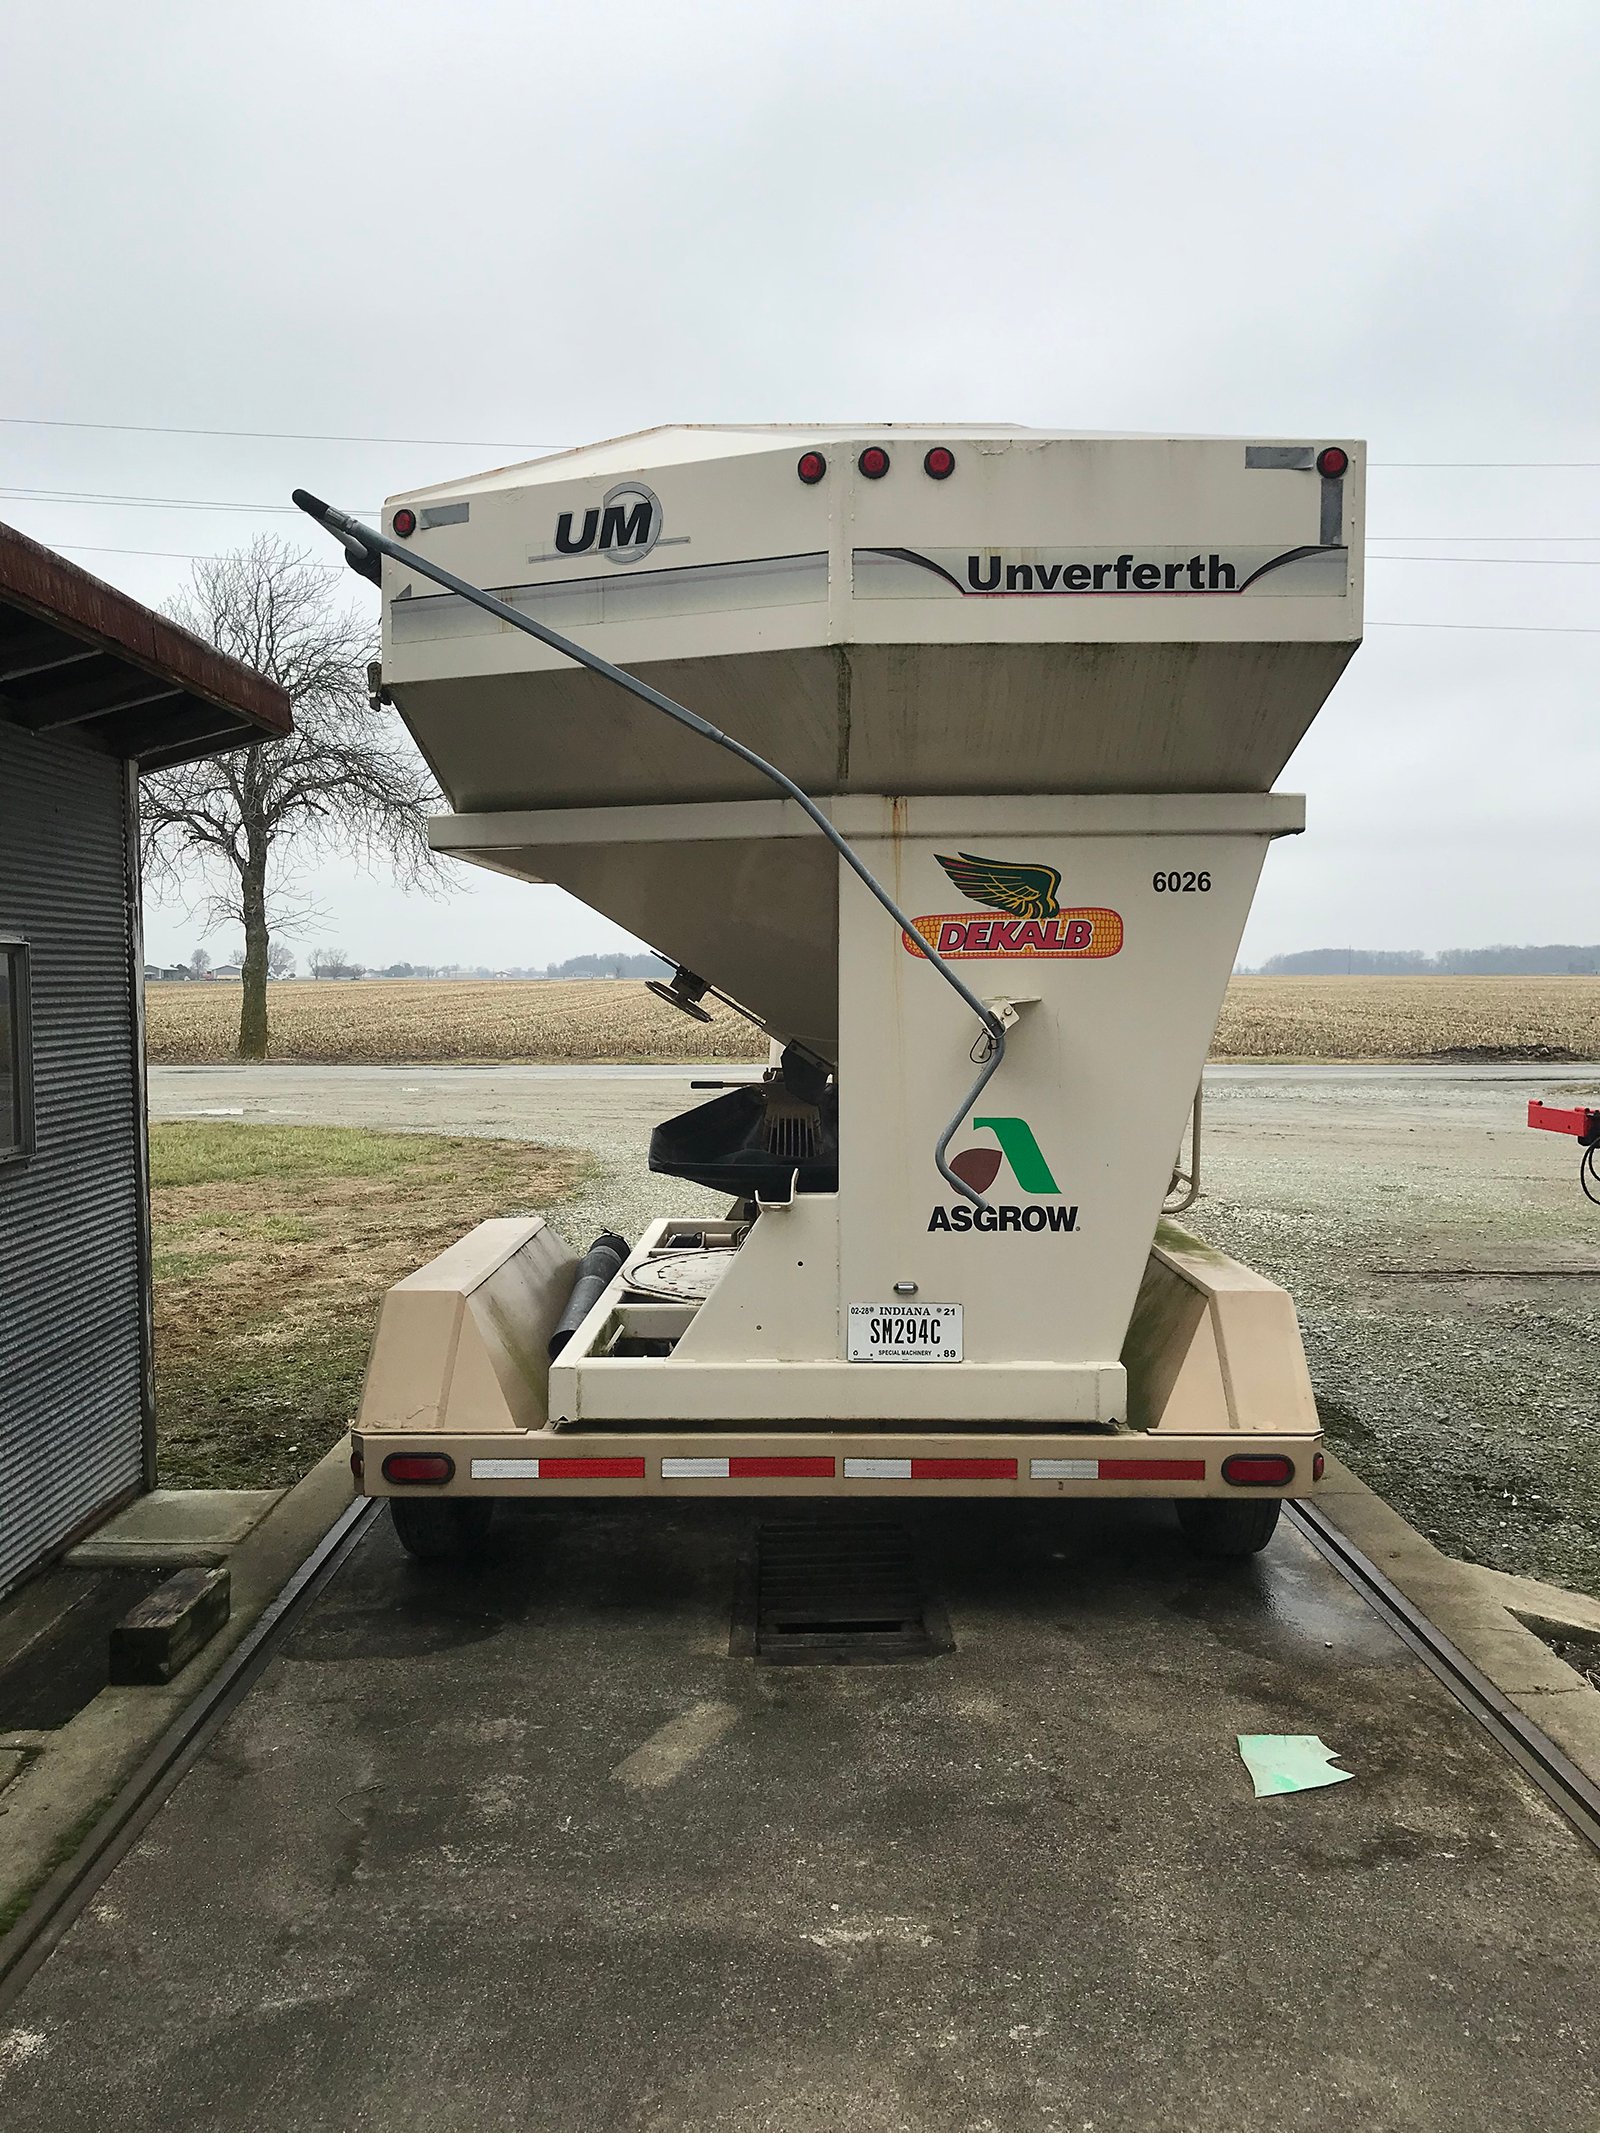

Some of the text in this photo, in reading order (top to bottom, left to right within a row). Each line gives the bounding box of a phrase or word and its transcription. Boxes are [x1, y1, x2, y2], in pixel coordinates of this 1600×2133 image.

[554, 502, 653, 554] UM
[968, 554, 1236, 591] Unverferth
[1152, 871, 1212, 893] 6026
[936, 918, 1093, 952] DEKALB
[927, 1205, 1078, 1232] ASGROW
[879, 1307, 931, 1316] INDIANA
[943, 1308, 955, 1316] 21
[870, 1318, 941, 1344] SM294C
[943, 1350, 956, 1358] 89
